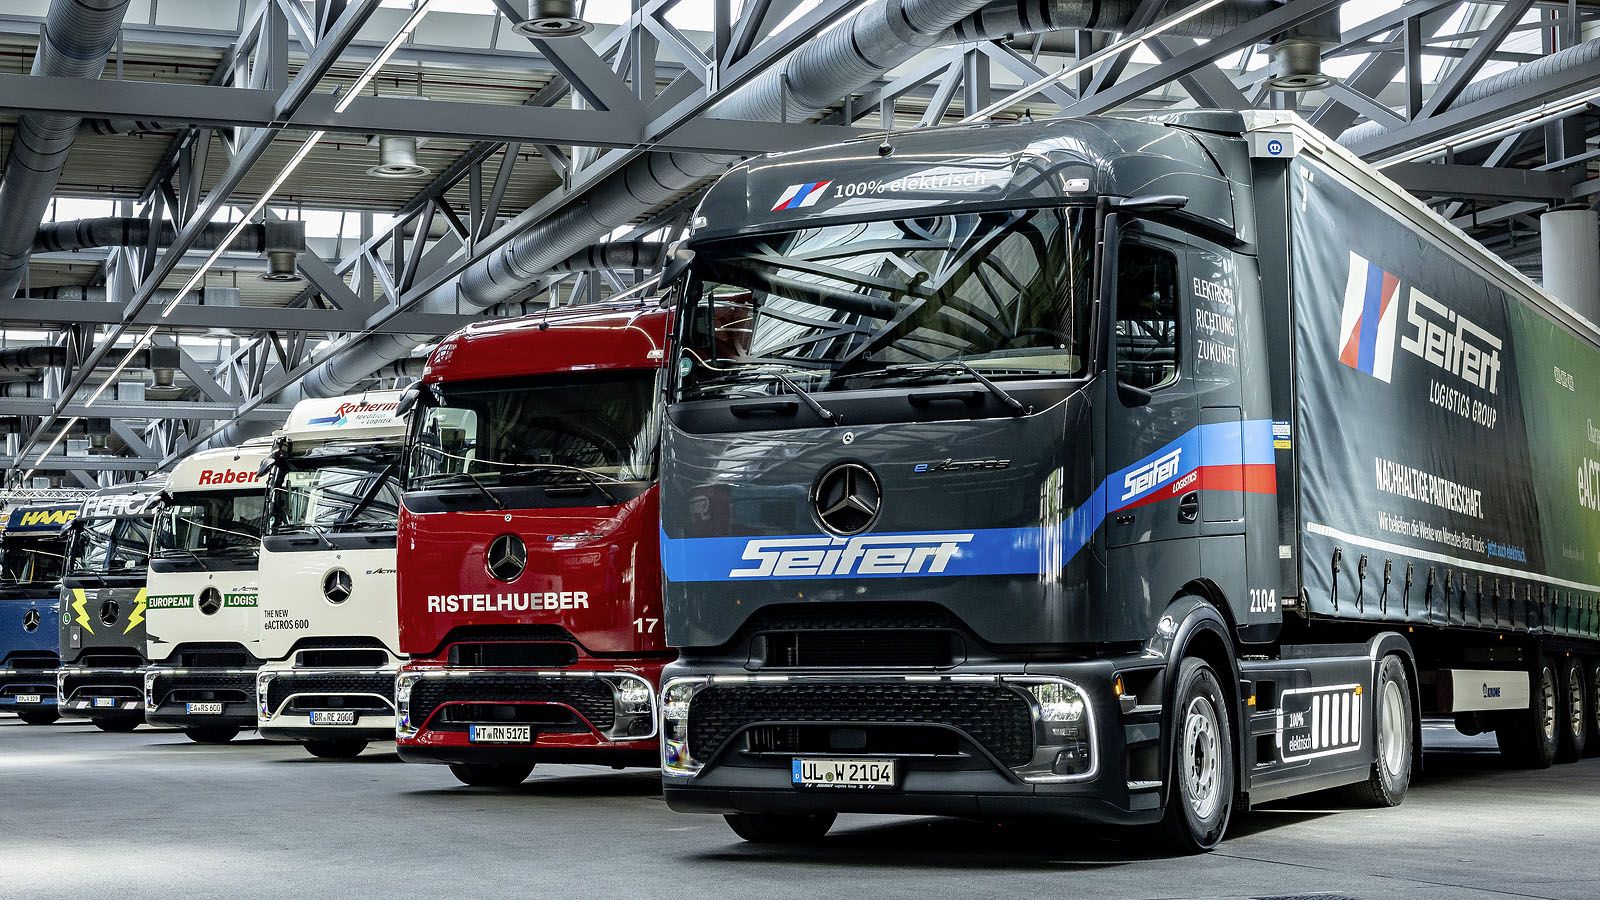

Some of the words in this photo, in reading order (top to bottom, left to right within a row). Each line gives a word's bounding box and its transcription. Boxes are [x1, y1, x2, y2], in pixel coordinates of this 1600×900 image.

[834, 180, 885, 198] 100%
[890, 171, 986, 192] elektrisch
[1193, 277, 1233, 305] ELEKTRISCH
[1196, 308, 1235, 336] RICHTUNG
[1401, 286, 1503, 394] Seifert
[1430, 379, 1470, 418] LOGISTICS
[1472, 400, 1497, 429] GROUP
[199, 469, 259, 485] Raben
[1121, 447, 1182, 501] Seifert
[1172, 471, 1197, 493] LOGISTICS
[1375, 457, 1429, 503] NACHHALTIGE
[729, 534, 974, 578] Seifert
[149, 597, 190, 607] EUROPEAN
[427, 592, 589, 613] RISTELHUEBER
[1250, 589, 1276, 612] 2104
[264, 610, 273, 618] THE
[264, 620, 293, 630] eACTROS
[294, 620, 309, 629] 600
[633, 618, 658, 634] 17
[1289, 712, 1304, 727] 100%
[493, 728, 504, 739] RN
[507, 728, 528, 739] 517E
[1289, 734, 1311, 751] elektrisch
[802, 763, 823, 780] UL
[835, 764, 844, 780] W
[849, 764, 890, 781] 2104
